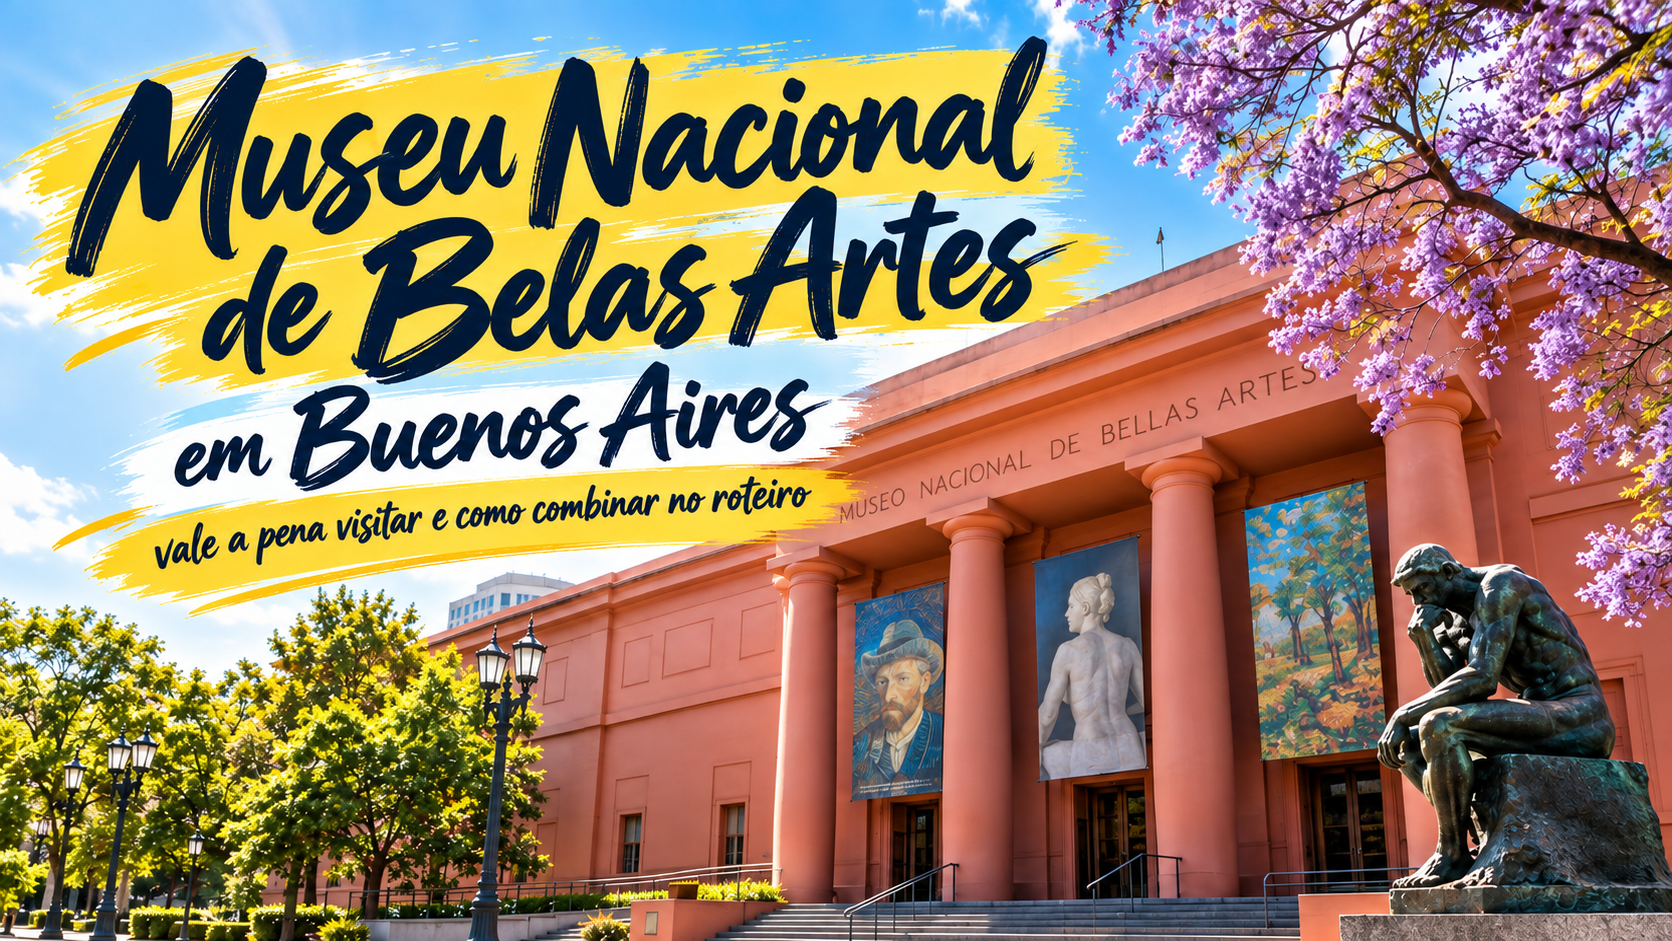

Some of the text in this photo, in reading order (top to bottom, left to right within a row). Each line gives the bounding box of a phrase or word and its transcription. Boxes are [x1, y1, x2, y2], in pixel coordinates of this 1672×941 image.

[840, 364, 1317, 524] MUSEO NACIONAL DE BELLAS ARTES
